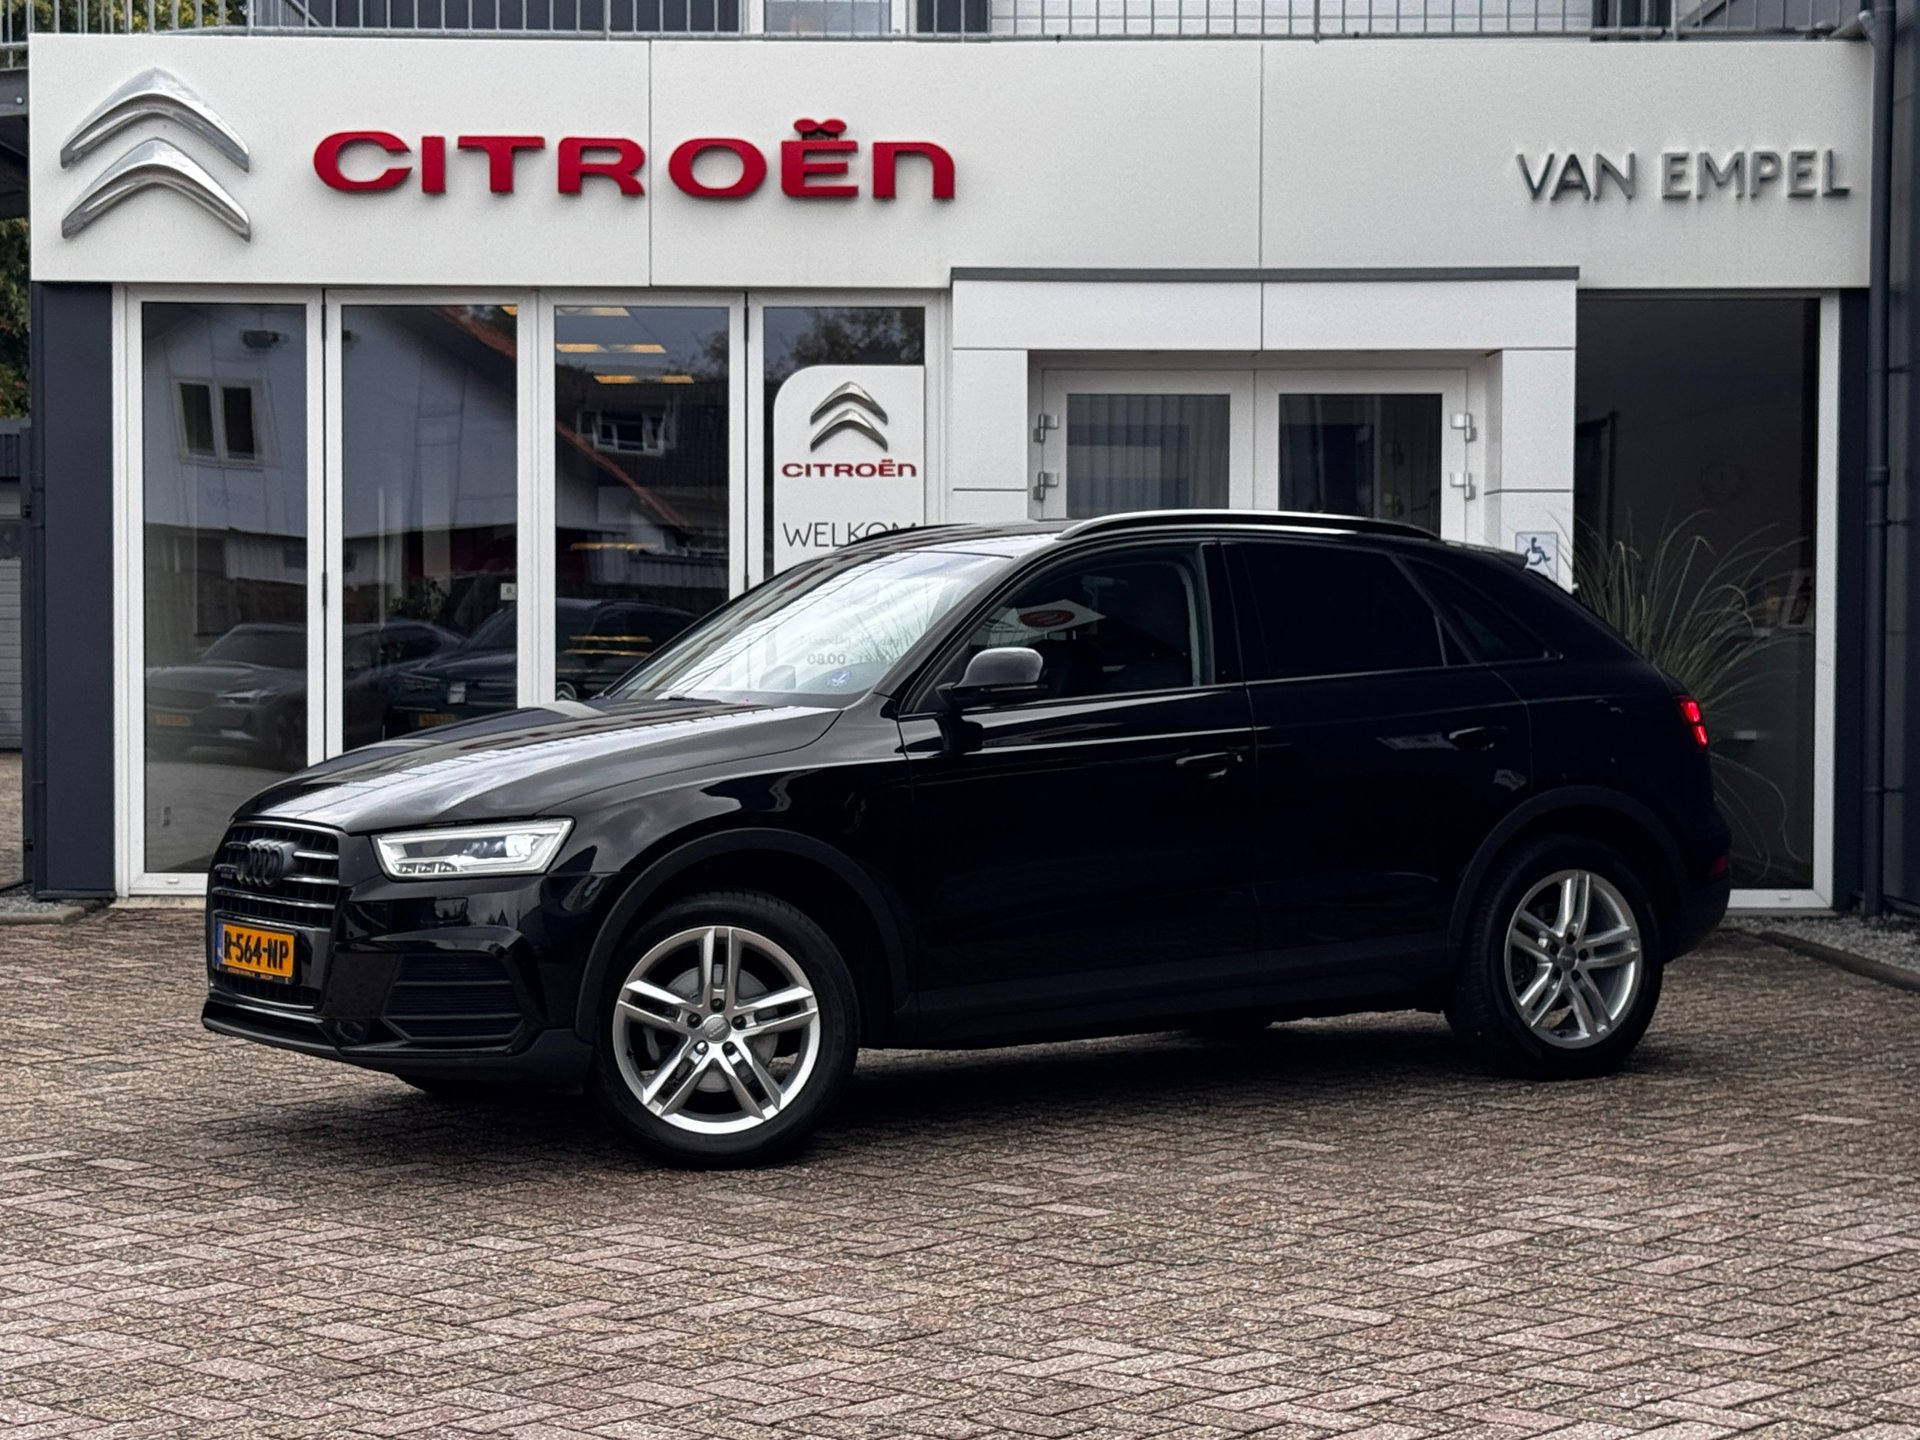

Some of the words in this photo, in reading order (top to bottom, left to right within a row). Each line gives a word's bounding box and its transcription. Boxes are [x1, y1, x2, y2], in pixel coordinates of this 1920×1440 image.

[1515, 151, 1637, 202] VAN
[1660, 148, 1852, 200] EMPEL
[782, 521, 917, 548] WELKO
[224, 930, 289, 970] R-564-NP
